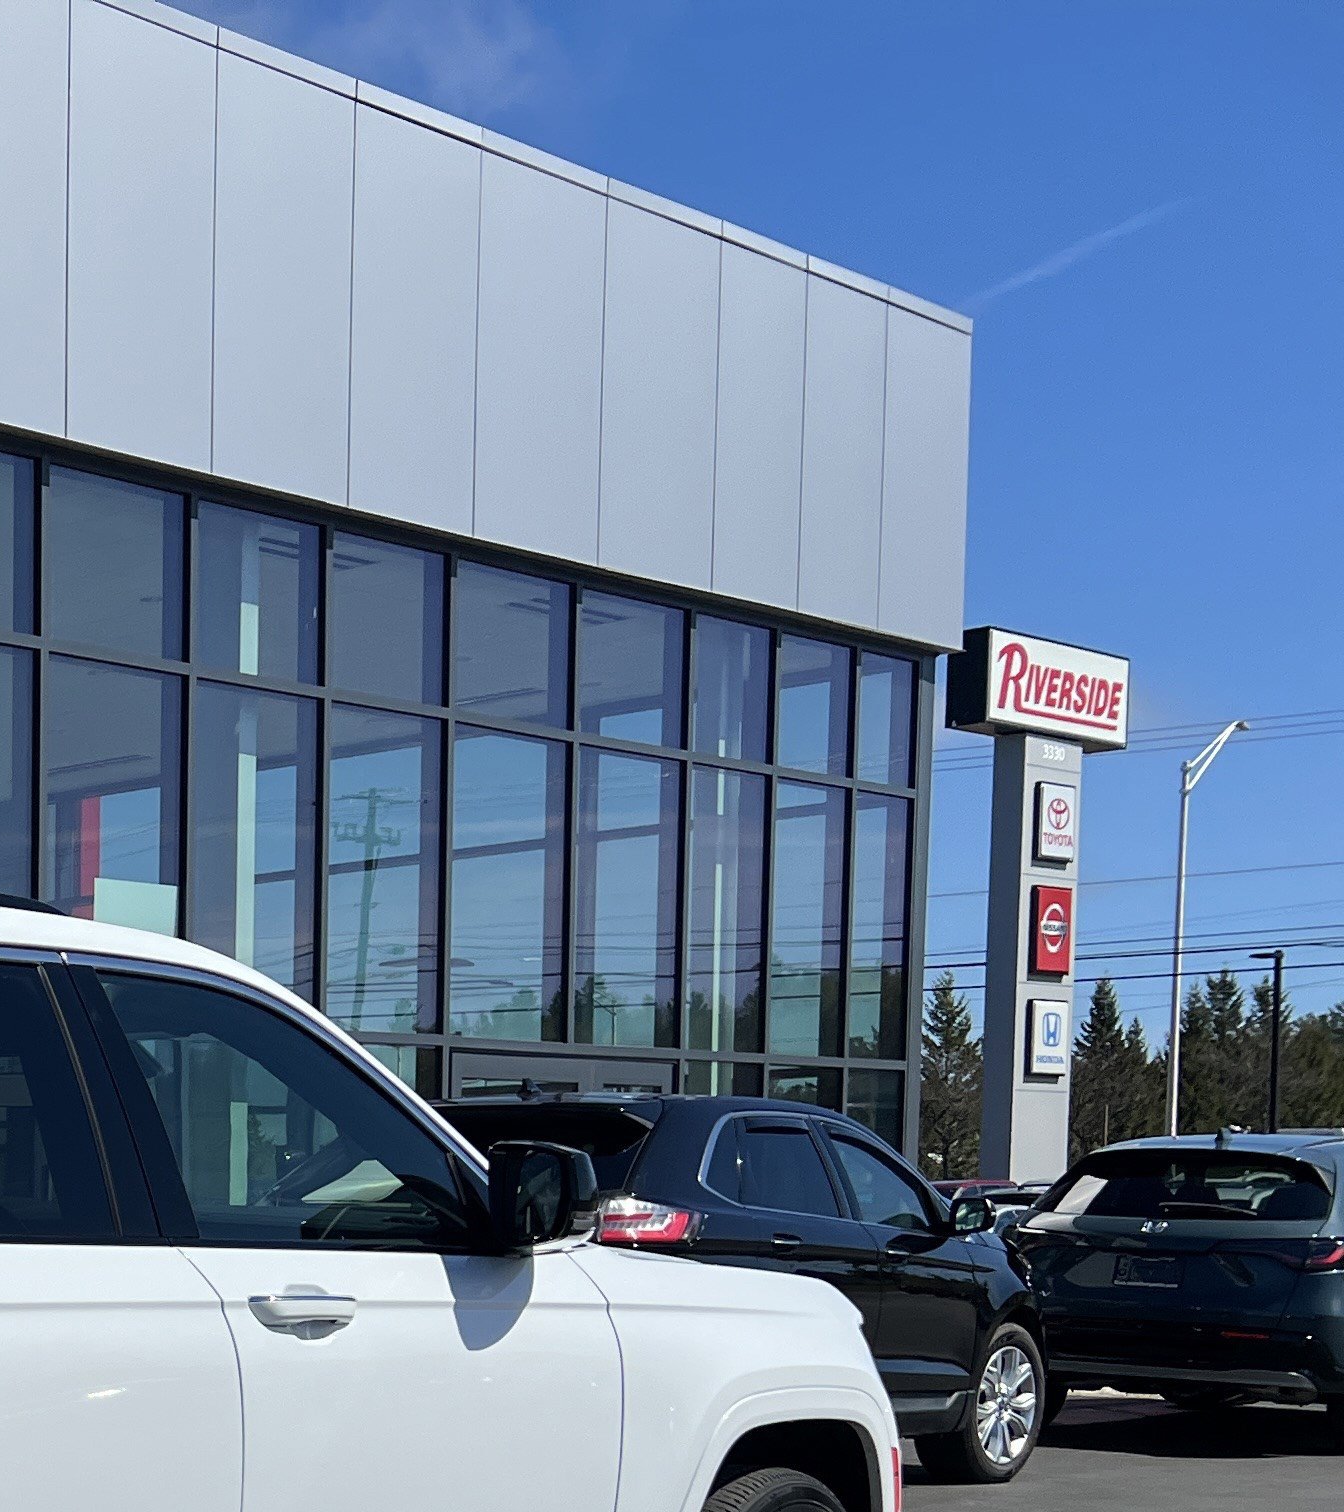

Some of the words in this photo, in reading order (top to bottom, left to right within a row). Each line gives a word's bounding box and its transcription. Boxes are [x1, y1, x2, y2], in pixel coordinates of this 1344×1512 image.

[1042, 744, 1066, 762] 3330
[1043, 832, 1073, 848] TOYOTA
[1036, 1054, 1065, 1065] HONDA
